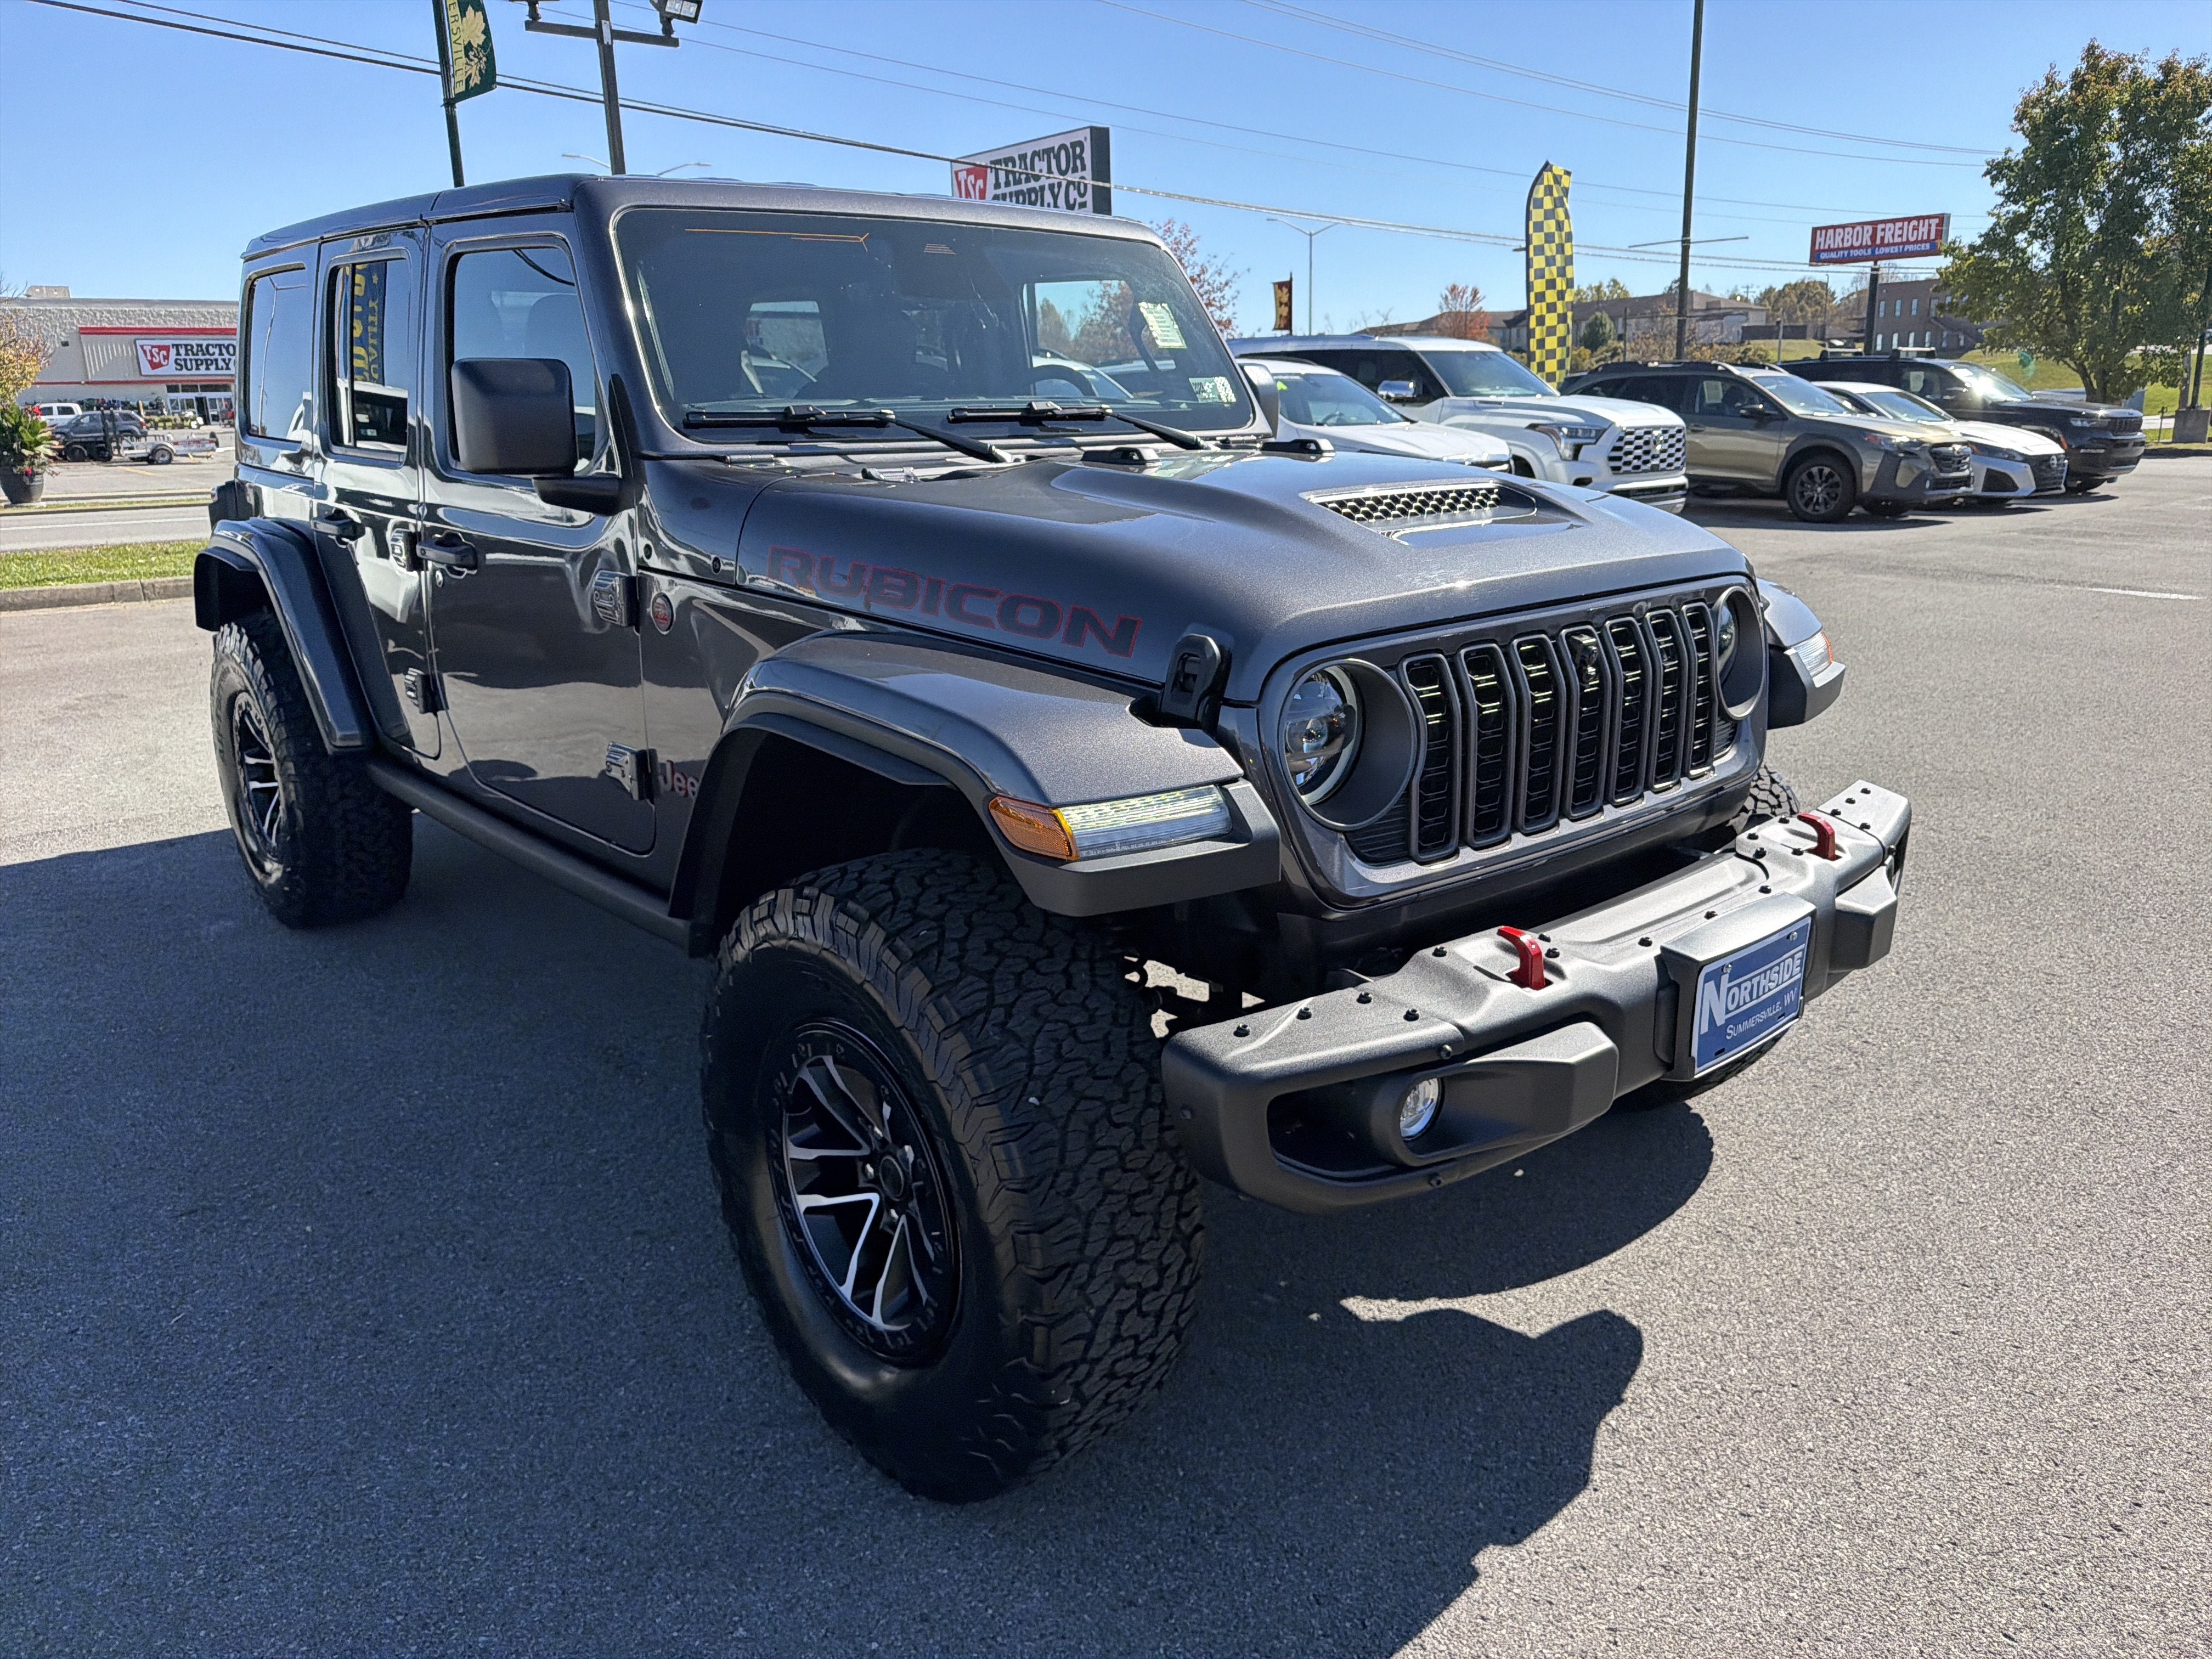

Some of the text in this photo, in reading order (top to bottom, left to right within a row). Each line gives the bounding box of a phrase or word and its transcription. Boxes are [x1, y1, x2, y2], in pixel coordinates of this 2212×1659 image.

[989, 140, 1087, 190] TRACTOR
[1815, 218, 1939, 249] HARBOR FREIGHT
[1820, 242, 1930, 259] QUALITY TOOLS LOWEST PRICES
[143, 346, 168, 365] TSC
[174, 358, 232, 371] SUPPLY
[768, 546, 1142, 658] RUBICON
[1700, 951, 1803, 1035] NORTHSIDE
[1784, 988, 1797, 1007] WV
